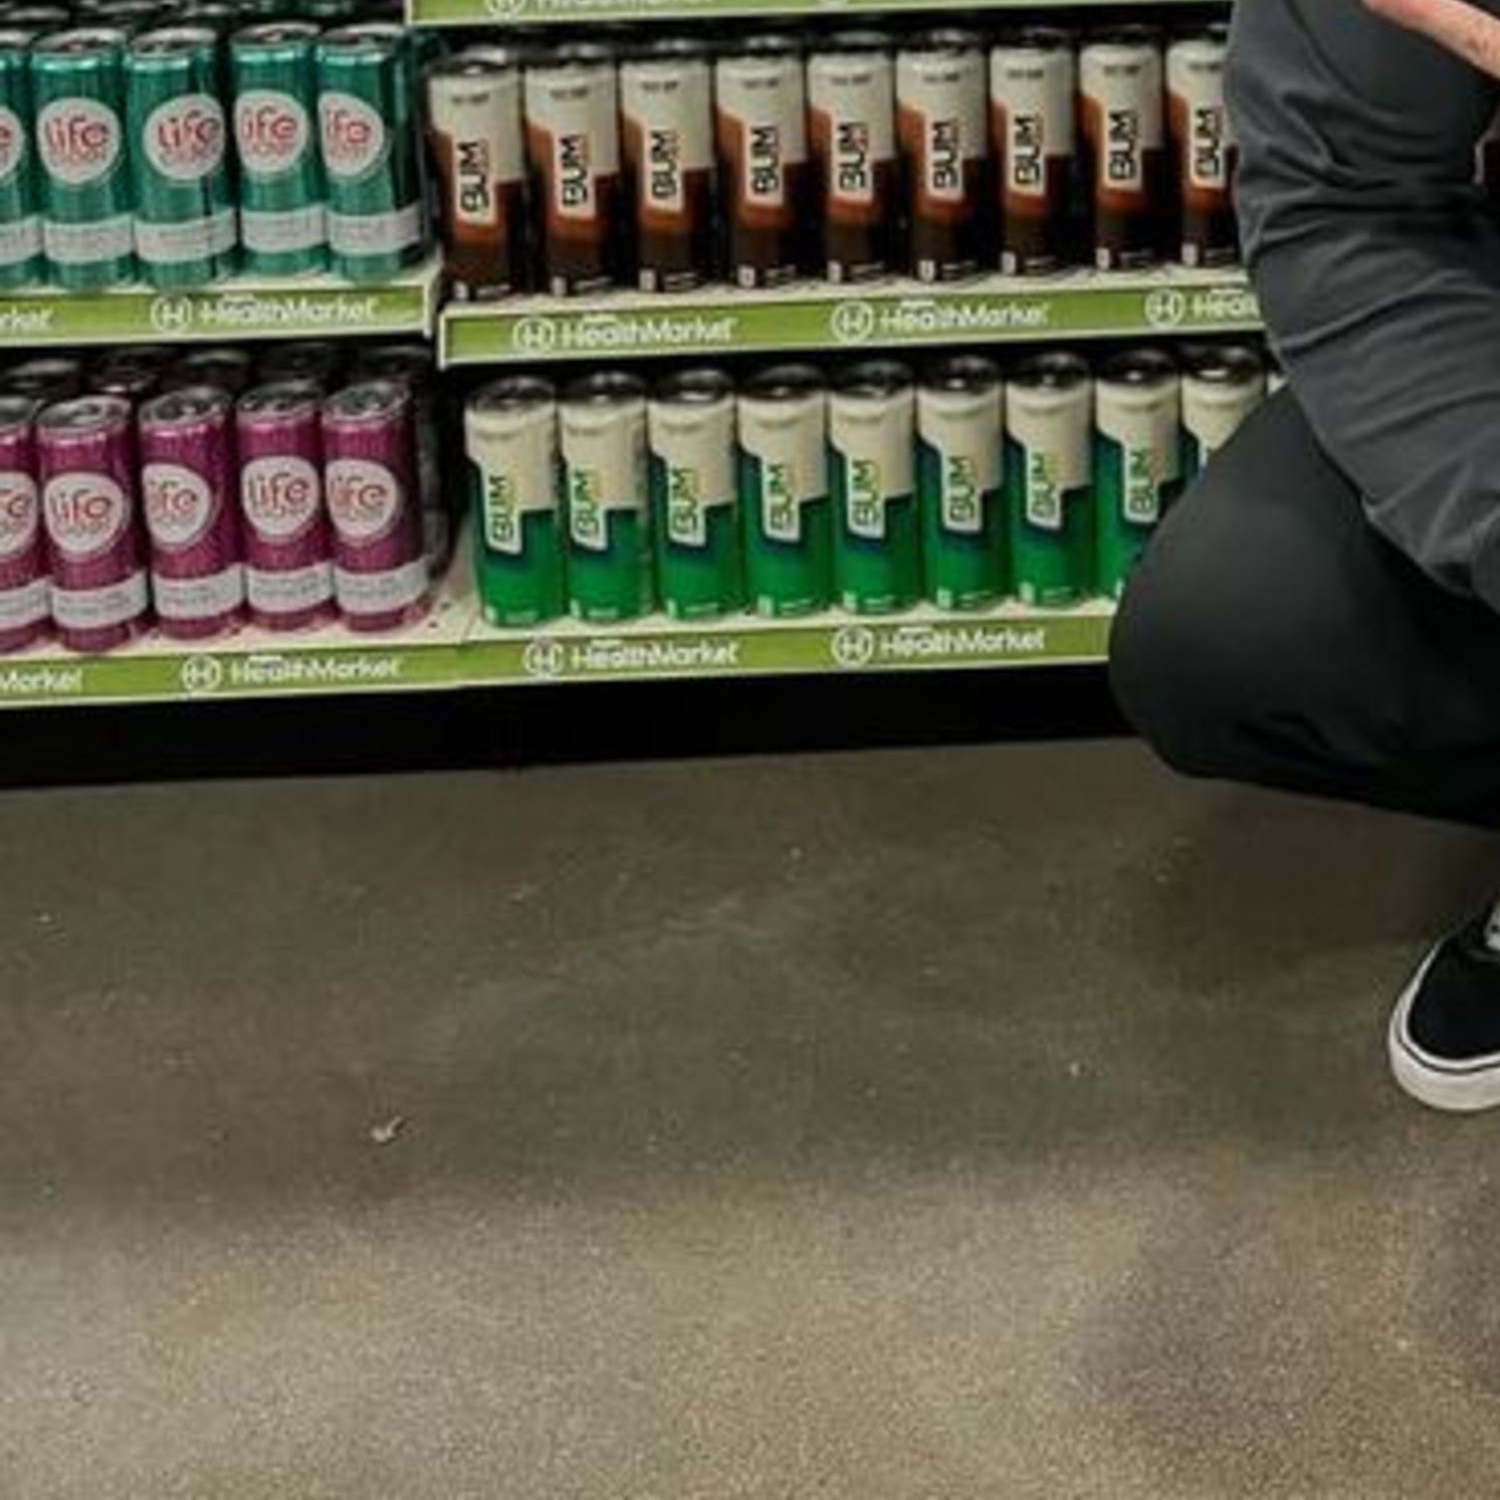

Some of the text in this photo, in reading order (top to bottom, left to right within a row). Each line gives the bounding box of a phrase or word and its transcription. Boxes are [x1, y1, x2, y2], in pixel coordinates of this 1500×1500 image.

[46, 115, 109, 155] life
[158, 111, 220, 152] life
[650, 130, 677, 198] BUM
[750, 126, 779, 194] BUM
[838, 123, 867, 190] BUM
[933, 121, 958, 188] BUM
[1014, 117, 1040, 184] BUM
[1108, 111, 1137, 180] BUM
[1196, 108, 1221, 176] BUM
[458, 143, 490, 211] BUM
[561, 134, 588, 205] BUM
[55, 488, 112, 524] life
[250, 471, 310, 512] life
